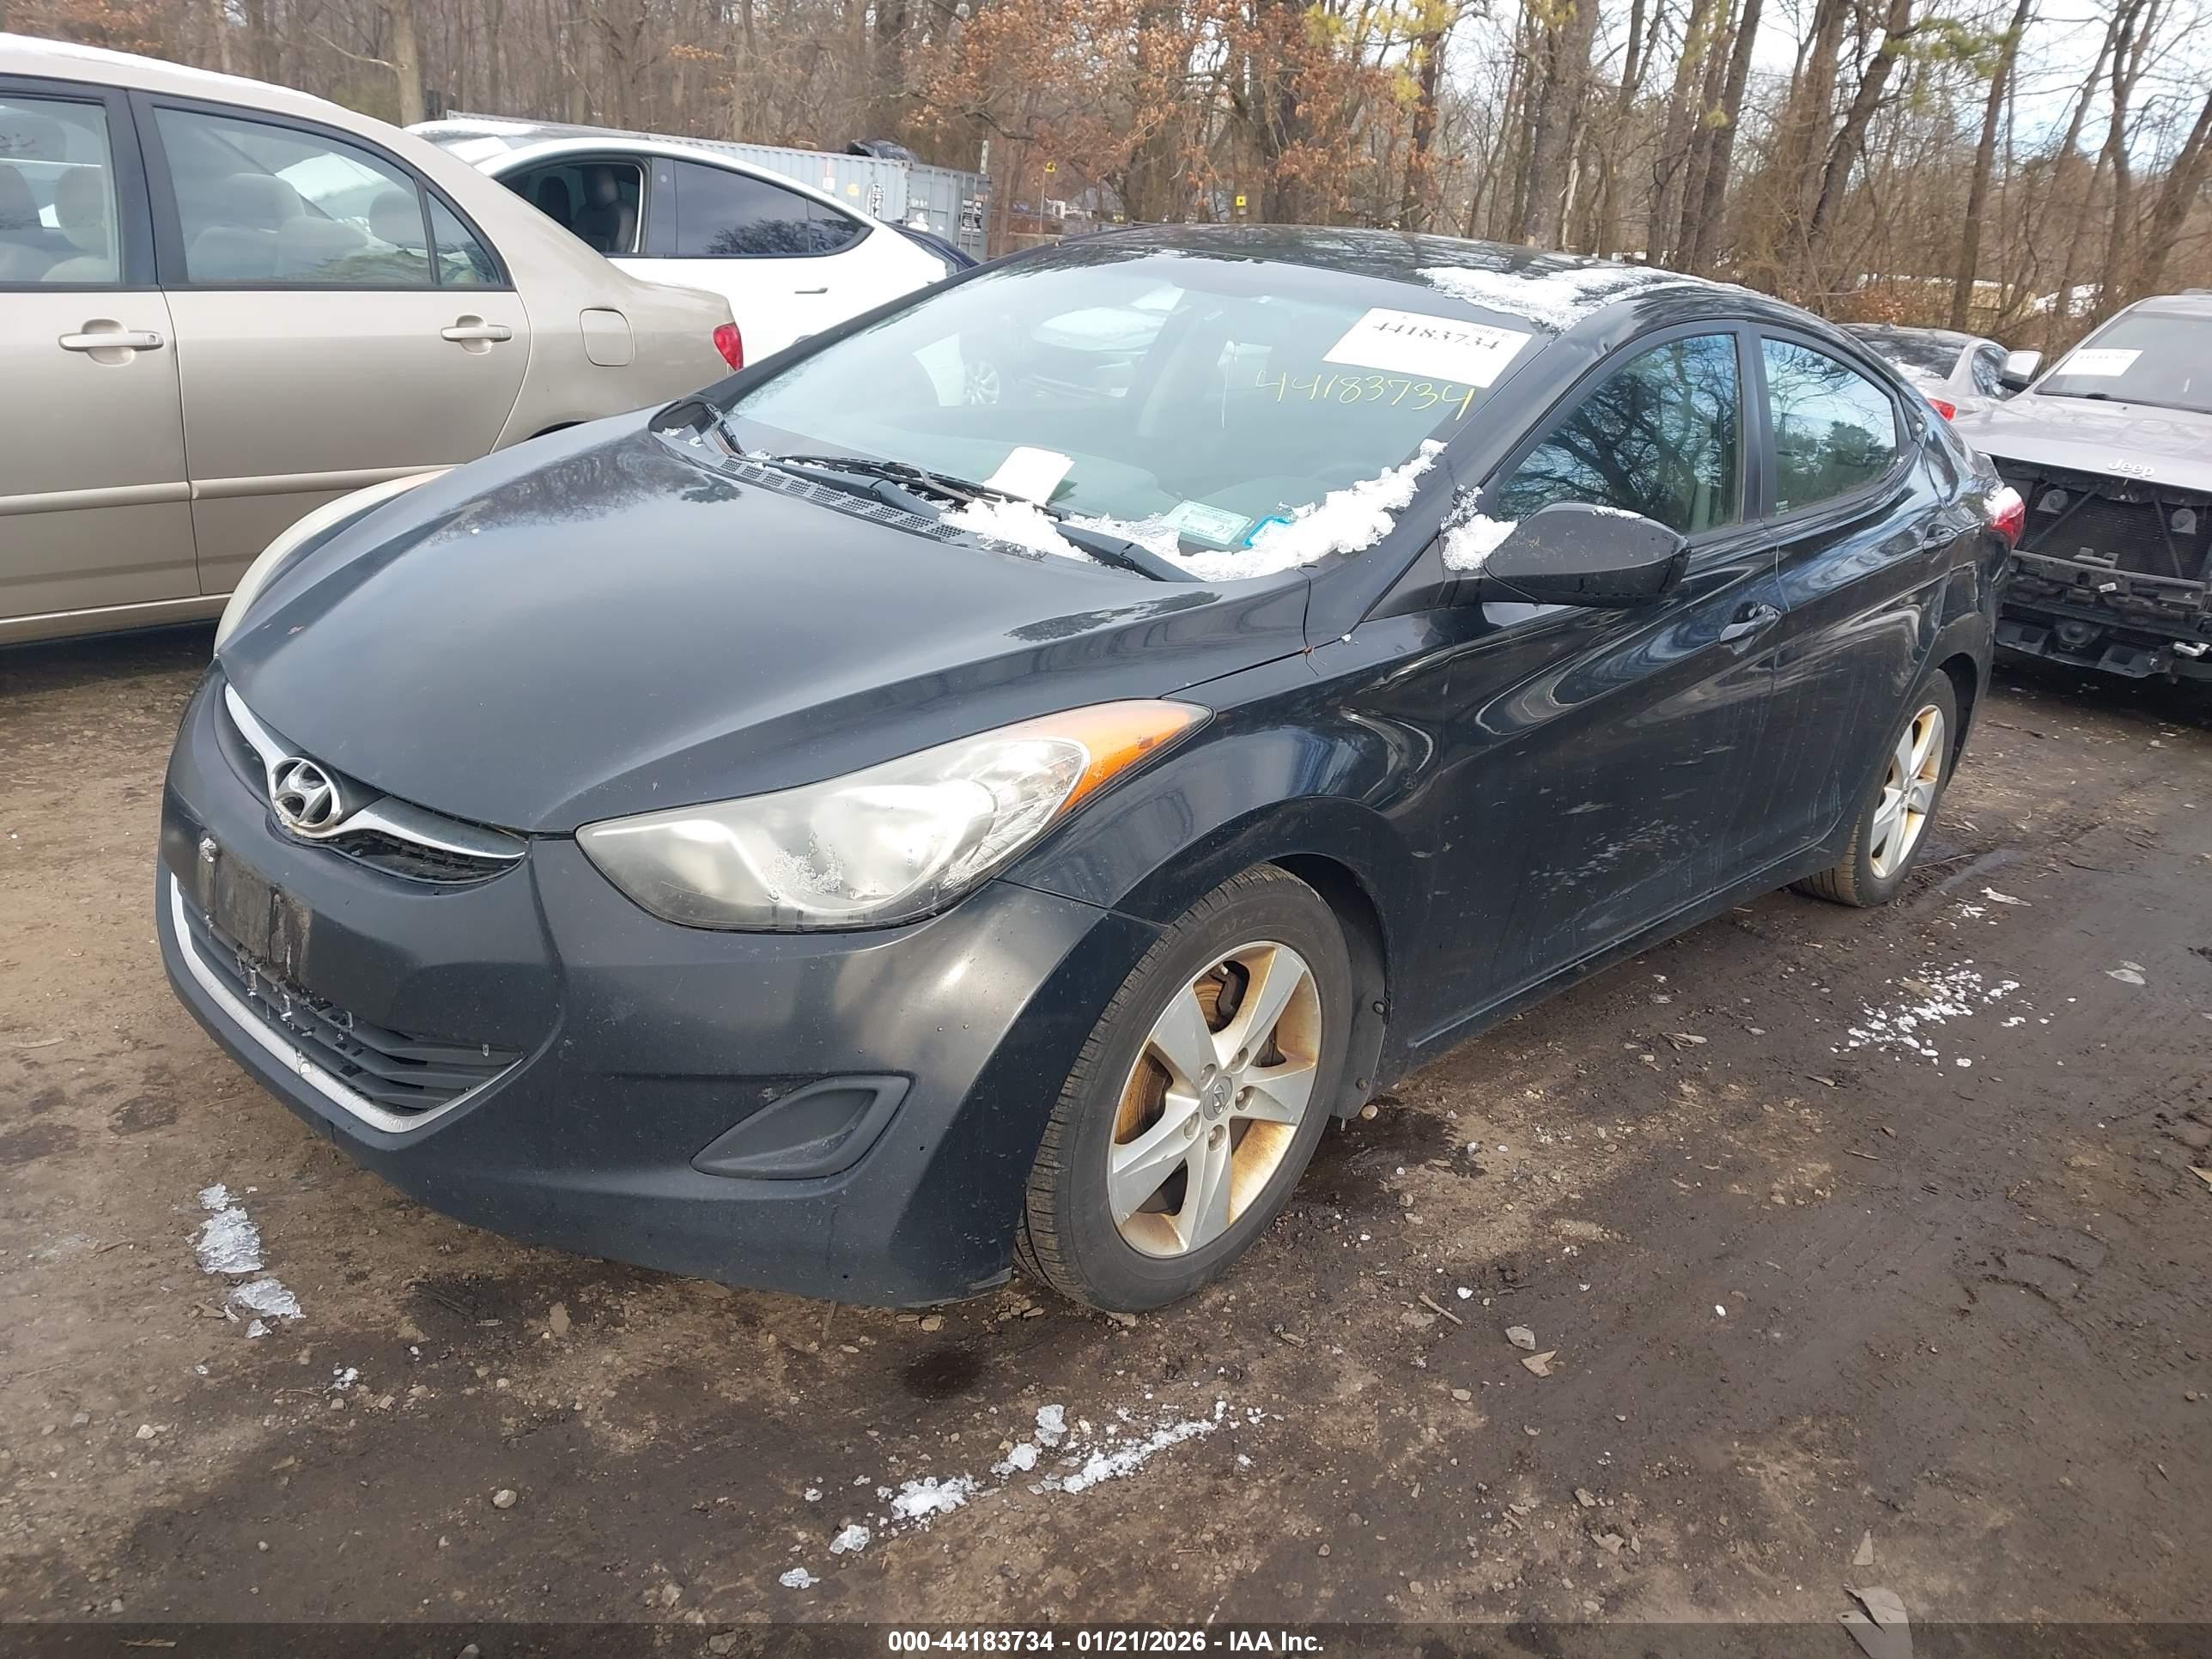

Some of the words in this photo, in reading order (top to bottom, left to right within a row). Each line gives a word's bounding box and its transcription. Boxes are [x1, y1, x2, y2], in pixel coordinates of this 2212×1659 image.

[1373, 321, 1500, 350] 44183734
[1255, 369, 1475, 421] 44183734
[2106, 458, 2155, 477] Jeep
